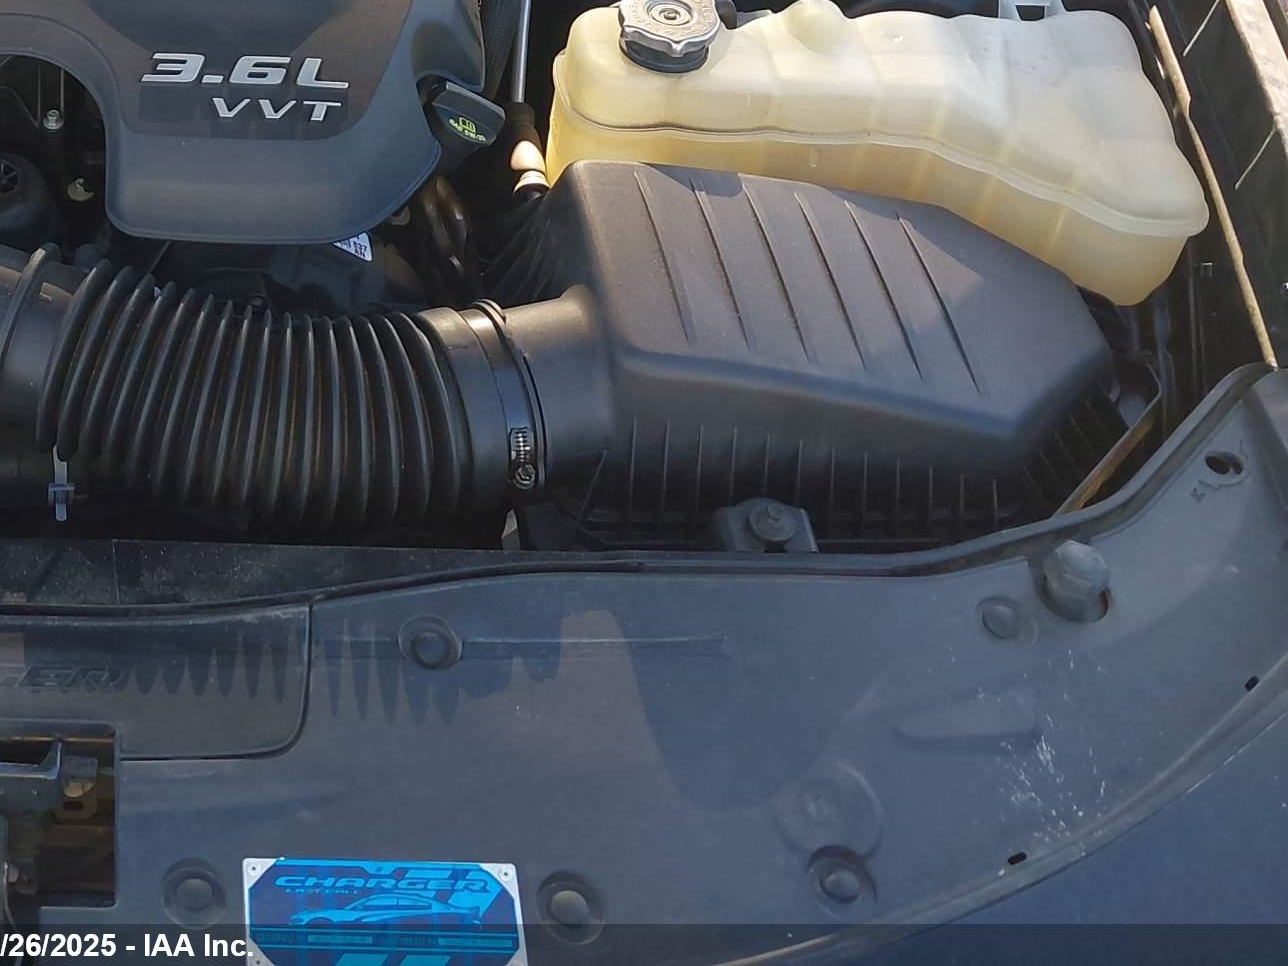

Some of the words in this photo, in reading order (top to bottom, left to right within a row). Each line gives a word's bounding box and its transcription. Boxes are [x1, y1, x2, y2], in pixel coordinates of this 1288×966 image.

[140, 52, 350, 90] 3.6L
[211, 97, 343, 122] VVT
[274, 874, 493, 894] CHARGER
